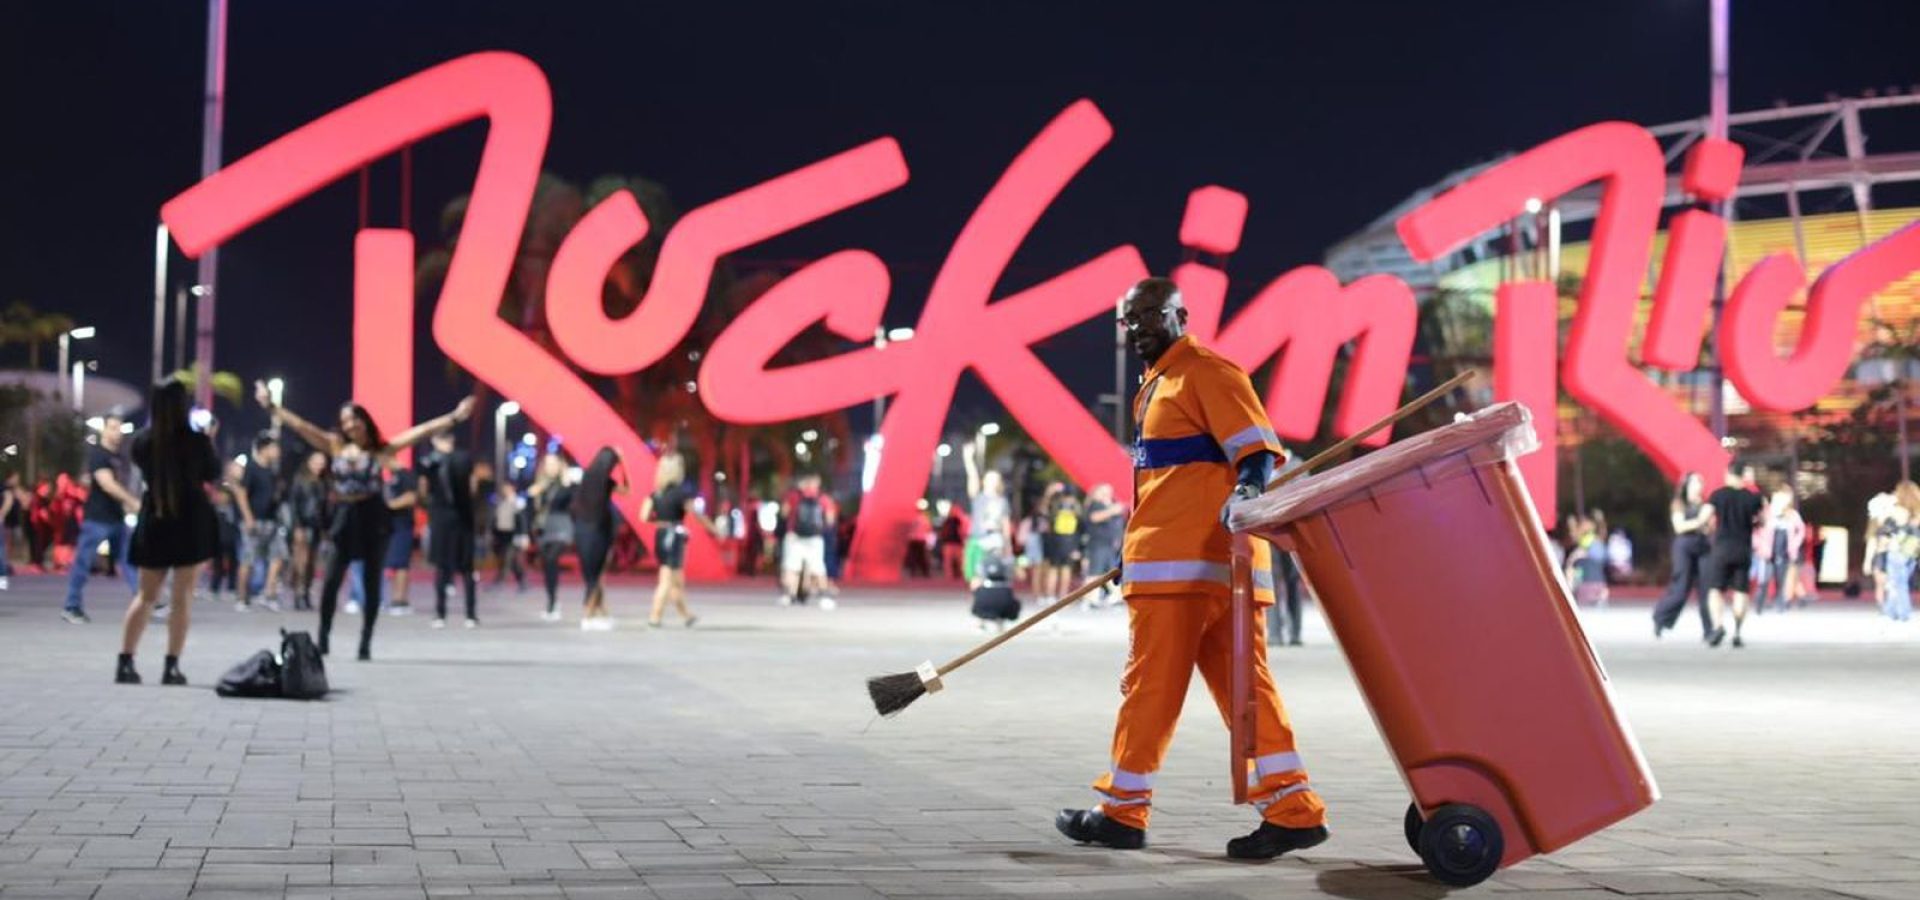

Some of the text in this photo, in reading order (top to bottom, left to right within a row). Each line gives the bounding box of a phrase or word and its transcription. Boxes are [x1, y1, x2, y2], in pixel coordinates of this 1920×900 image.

[163, 51, 1920, 580] Rock in Rio
